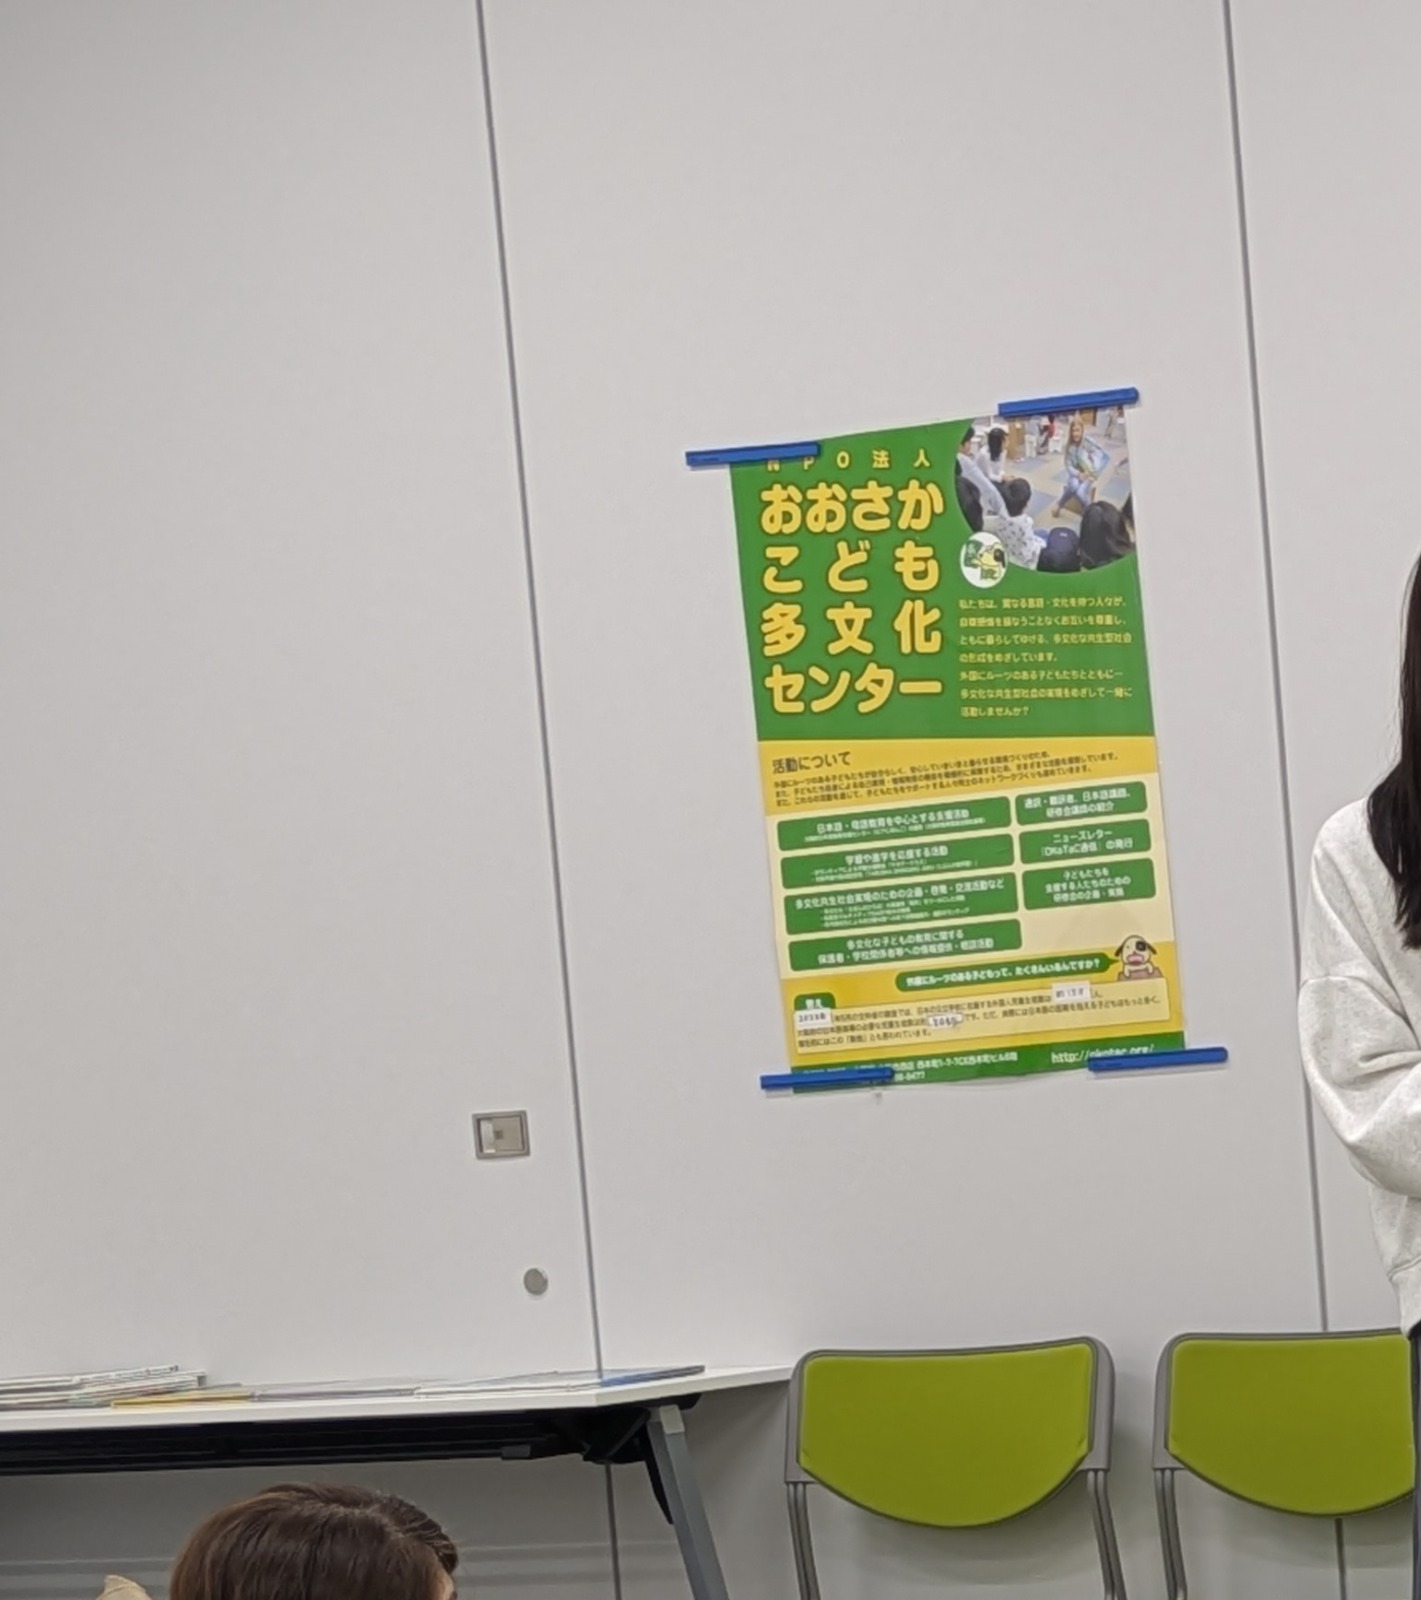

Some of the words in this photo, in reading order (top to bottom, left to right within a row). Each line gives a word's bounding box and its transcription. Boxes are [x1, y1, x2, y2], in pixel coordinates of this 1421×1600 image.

[760, 479, 944, 535] おおさか
[762, 540, 940, 593] こども
[761, 600, 942, 657] 多文化
[764, 662, 943, 713] センター
[772, 751, 851, 774] 活動について
